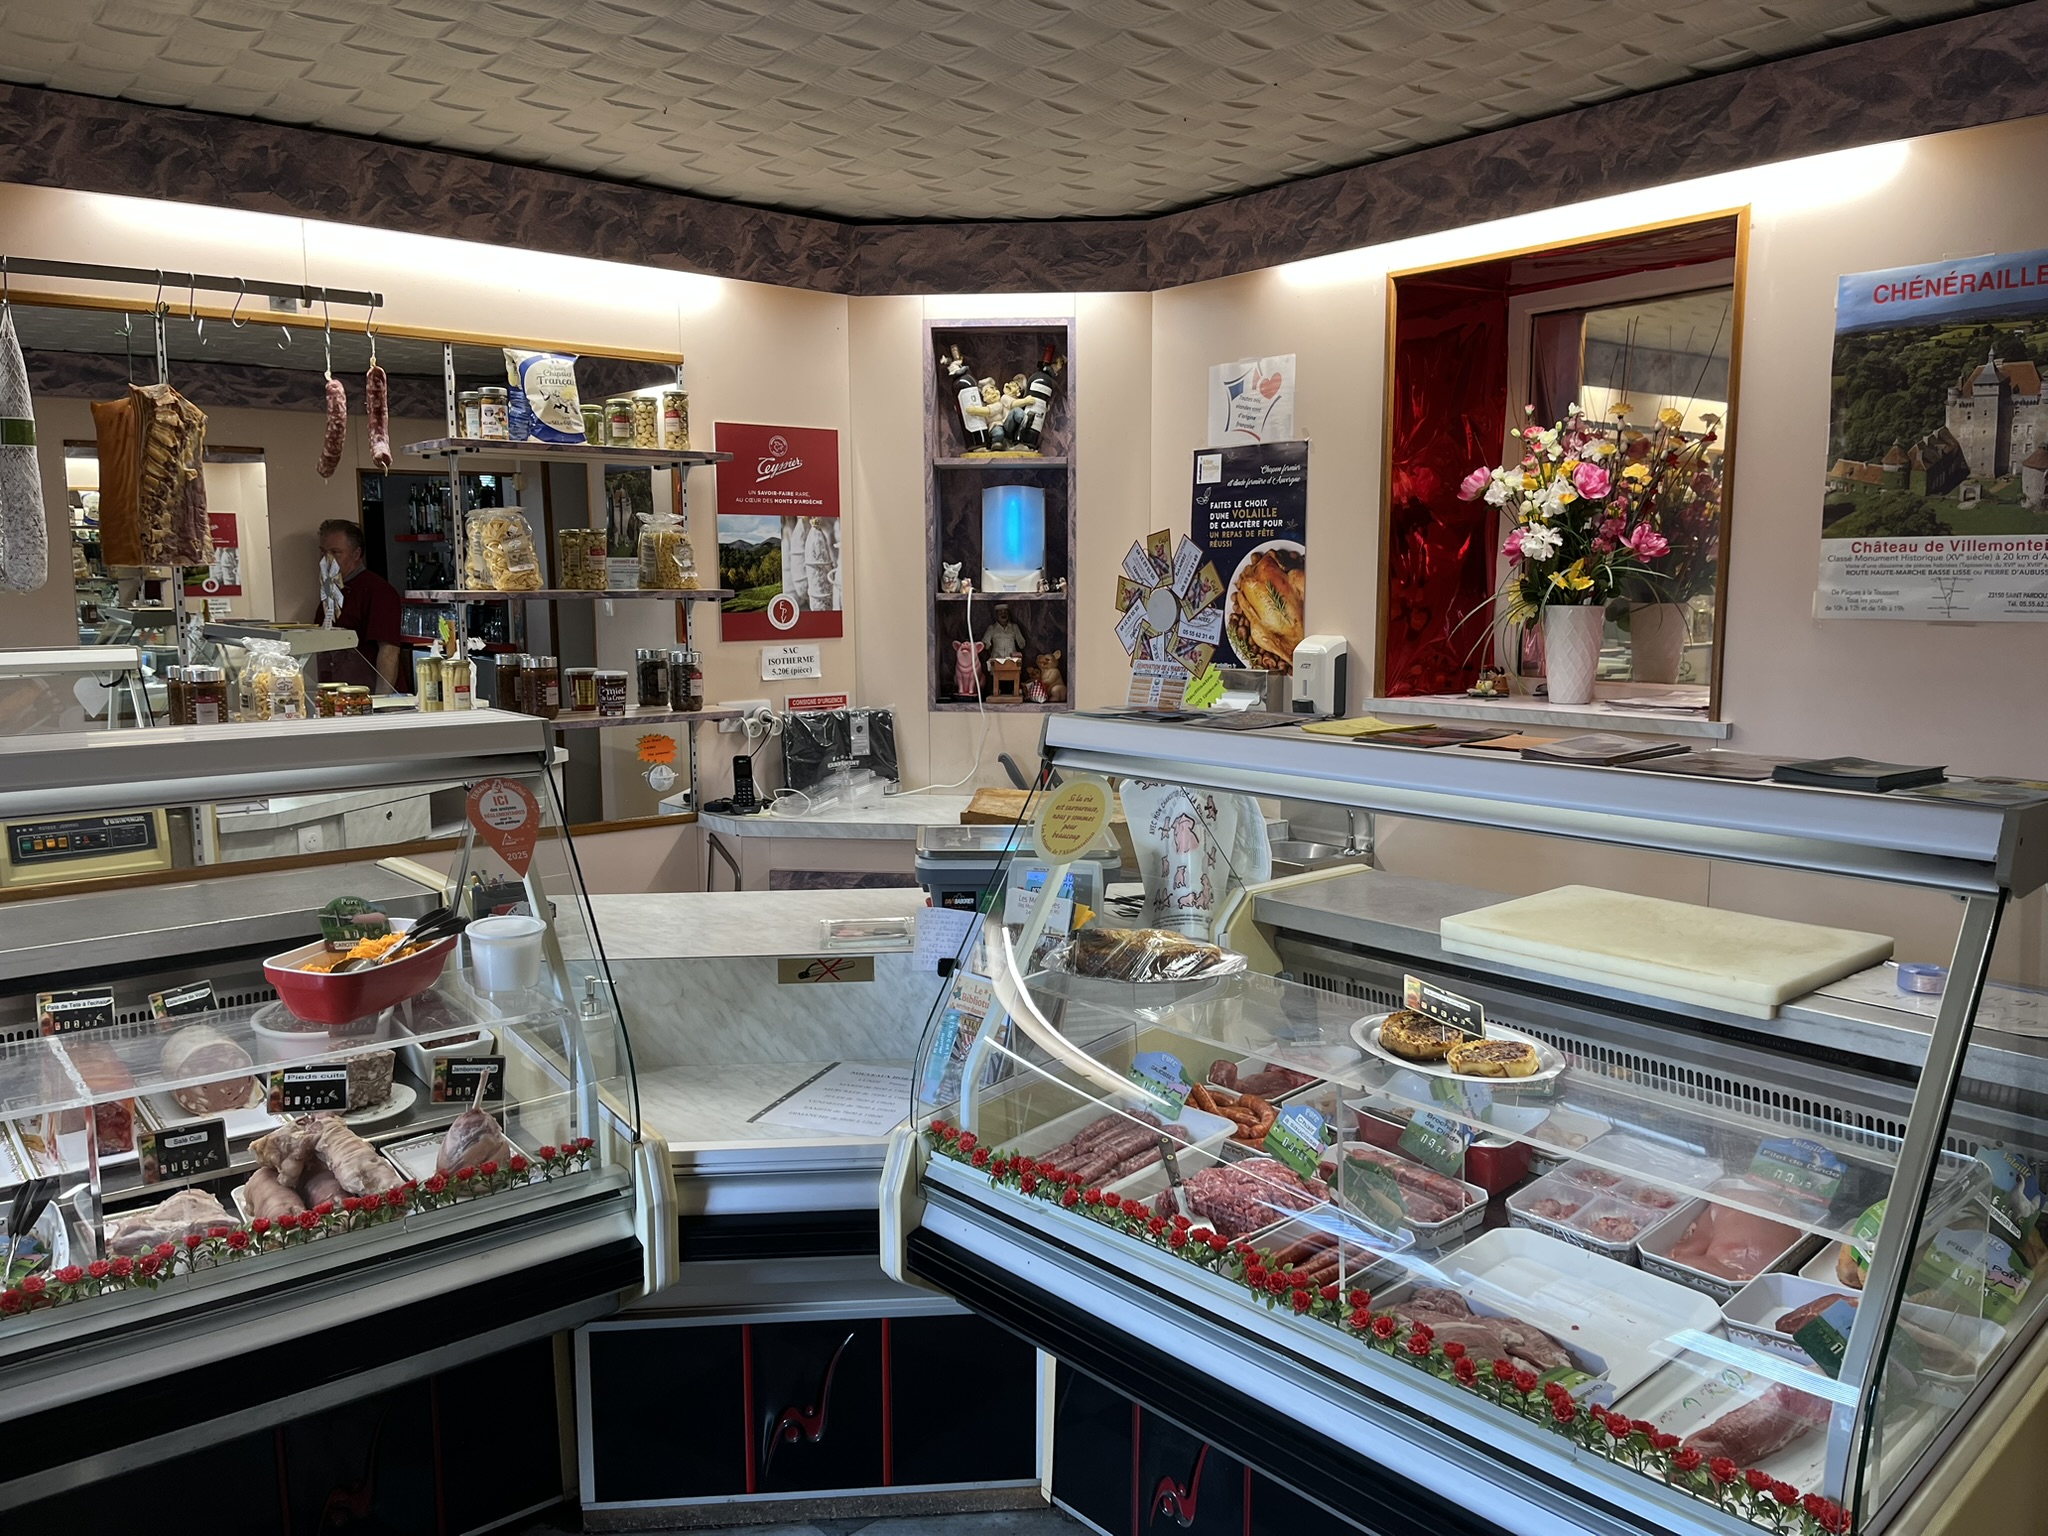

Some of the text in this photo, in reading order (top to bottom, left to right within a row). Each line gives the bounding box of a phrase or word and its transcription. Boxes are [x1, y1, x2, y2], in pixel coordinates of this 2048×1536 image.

[1238, 413, 1256, 421] d'origine
[1236, 421, 1255, 429] française
[1267, 476, 1300, 486] d'Auvergne
[1210, 501, 1231, 509] FAITES
[1245, 499, 1268, 508] CHOIX
[1210, 508, 1277, 520] D'UNE VOLAILLE
[1221, 520, 1260, 529] CARACTÈRE
[1263, 519, 1283, 527] POUR
[1258, 528, 1274, 537] FÊTE
[1209, 539, 1232, 548] RÉUSSI
[1851, 541, 1918, 554] Château
[1925, 541, 1944, 553] de
[1901, 554, 1943, 562] Historique
[1966, 553, 1993, 561] siècle)
[768, 656, 814, 666] ISOTHERME
[791, 666, 812, 675] (pièce)
[606, 686, 625, 696] Miel
[792, 696, 843, 706] CONSIGNE D'URGENCE
[493, 795, 509, 806] ICI
[484, 810, 525, 819] RÉGLEMENTAIRES
[1063, 815, 1071, 823] y
[1149, 808, 1162, 835] AVEC MON
[1060, 824, 1078, 832] pour
[1051, 830, 1080, 843] beaucoup
[507, 850, 528, 860] 2025
[975, 985, 983, 995] Le
[1305, 1108, 1320, 1122] Porc
[1298, 1116, 1315, 1133] Chair
[1291, 1122, 1317, 1147] saucisse
[1424, 1120, 1460, 1144] de Dinde
[1792, 1139, 1825, 1153] Volaille
[1762, 1149, 1840, 1178] Filet de Dinde
[2004, 1152, 2032, 1178] Volaille
[1946, 1240, 1973, 1258] Filet
[1992, 1264, 2022, 1284] Porc
